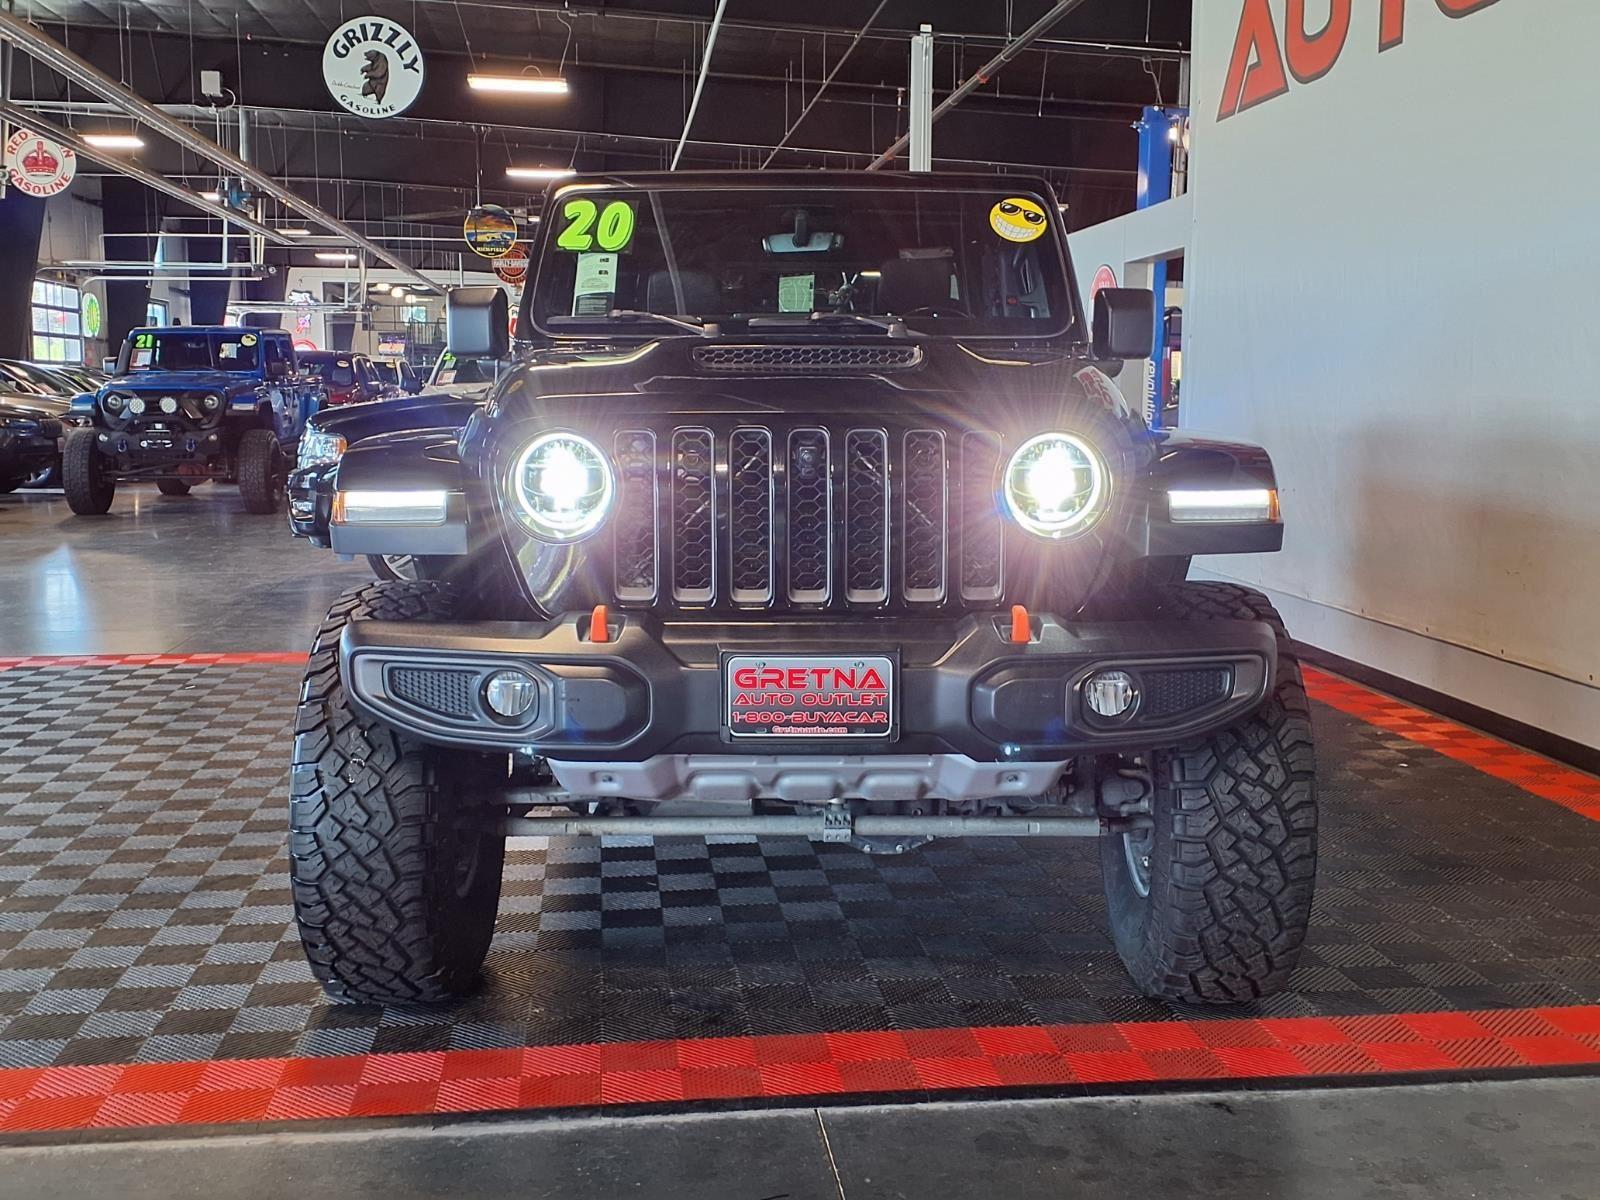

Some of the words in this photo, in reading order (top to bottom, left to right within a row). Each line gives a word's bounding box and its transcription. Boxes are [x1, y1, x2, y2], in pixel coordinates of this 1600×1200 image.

[333, 22, 419, 74] GRIZZLY
[1216, 0, 1500, 122] AU
[340, 94, 396, 114] GASOLINE
[7, 131, 29, 155] RED
[9, 168, 71, 195] GASOLINE
[557, 200, 635, 251] 20
[135, 334, 153, 348] 21
[733, 667, 888, 690] GRETNA
[733, 693, 795, 706] AUTO
[801, 693, 888, 706] OUTLET
[732, 711, 888, 724] 1-800-BUYACAR
